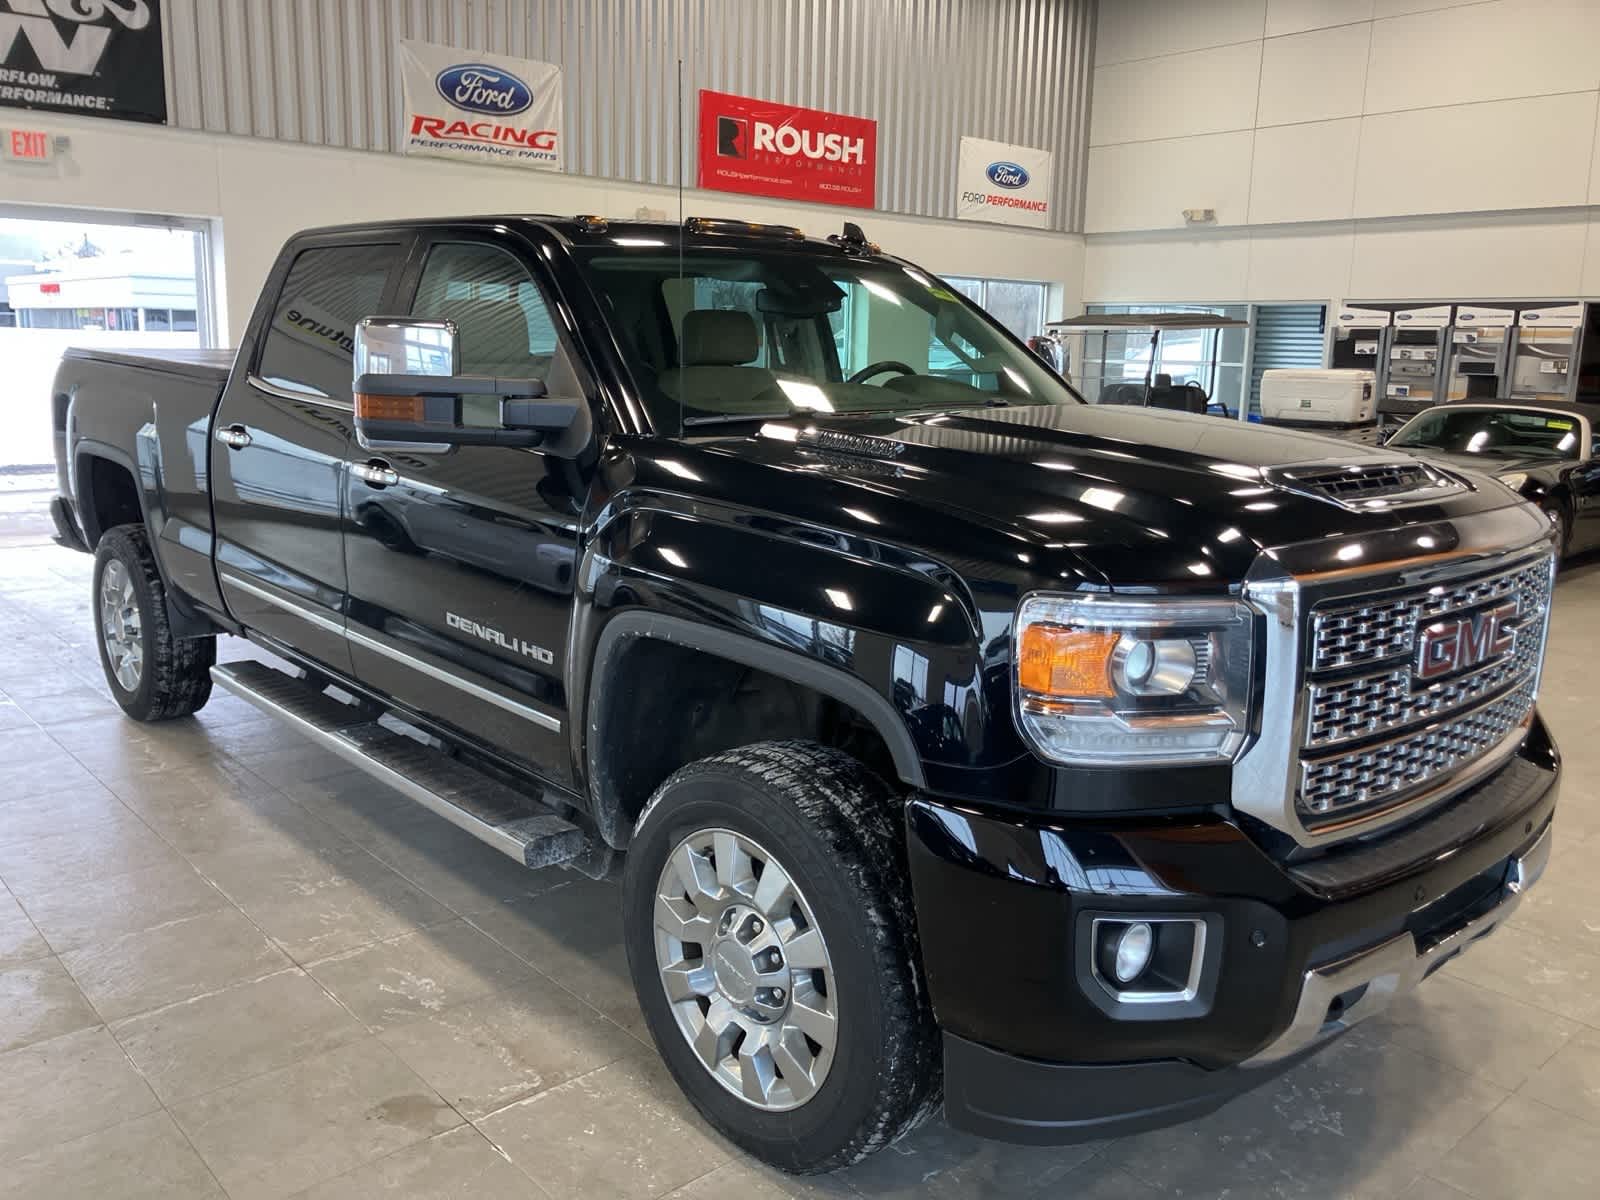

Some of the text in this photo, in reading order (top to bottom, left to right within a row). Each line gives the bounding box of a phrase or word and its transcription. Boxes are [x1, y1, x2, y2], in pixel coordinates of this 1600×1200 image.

[0, 85, 111, 111] RFORMANCE.
[455, 71, 515, 110] Ford
[11, 131, 47, 159] EXIT
[410, 115, 558, 150] RACING
[753, 121, 865, 165] ROUSH
[410, 138, 557, 161] PERFORMANCE PARTS
[994, 165, 1021, 185] Ford
[962, 192, 1048, 212] FORD PERFORMANCE
[446, 611, 554, 665] DENALI HD
[1417, 600, 1520, 680] GMC
